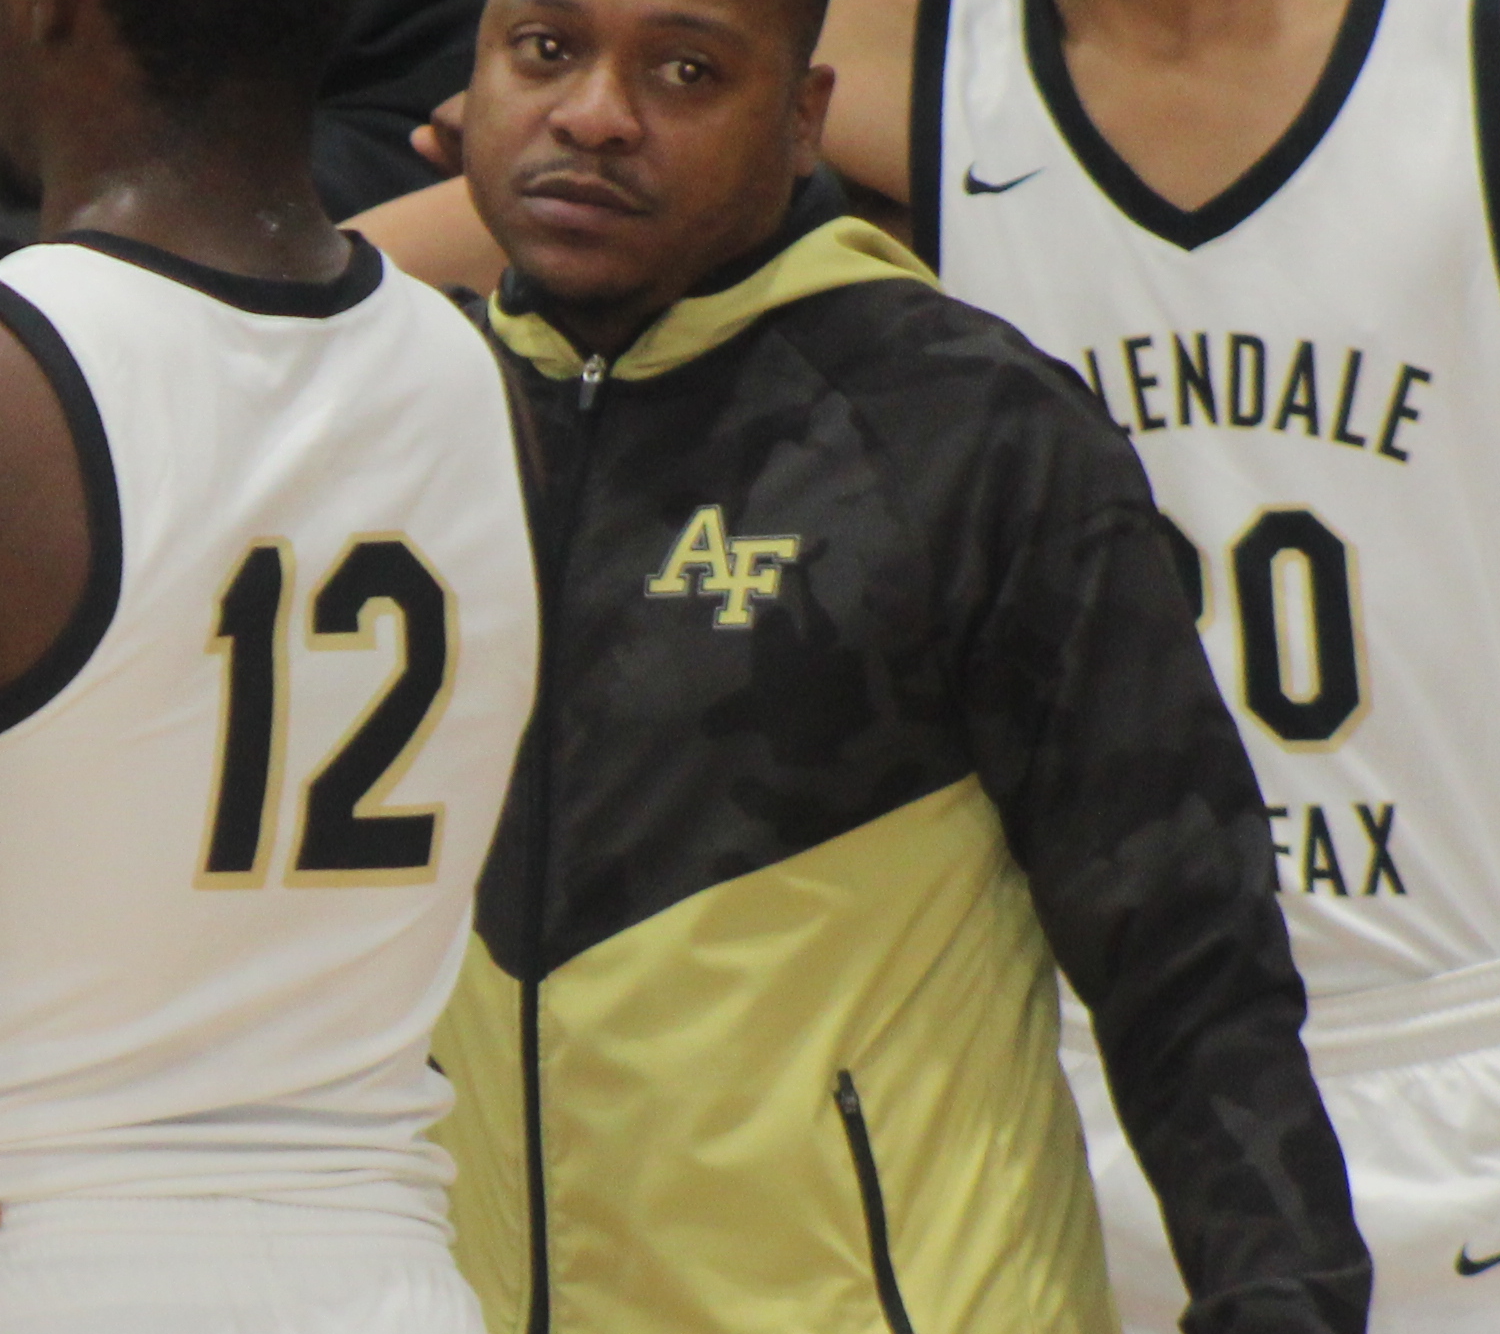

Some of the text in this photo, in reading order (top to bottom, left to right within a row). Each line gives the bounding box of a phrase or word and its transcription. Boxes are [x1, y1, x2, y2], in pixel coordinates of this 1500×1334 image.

[645, 503, 799, 628] AF
[1155, 503, 1370, 753] 0
[194, 533, 458, 891] 12
